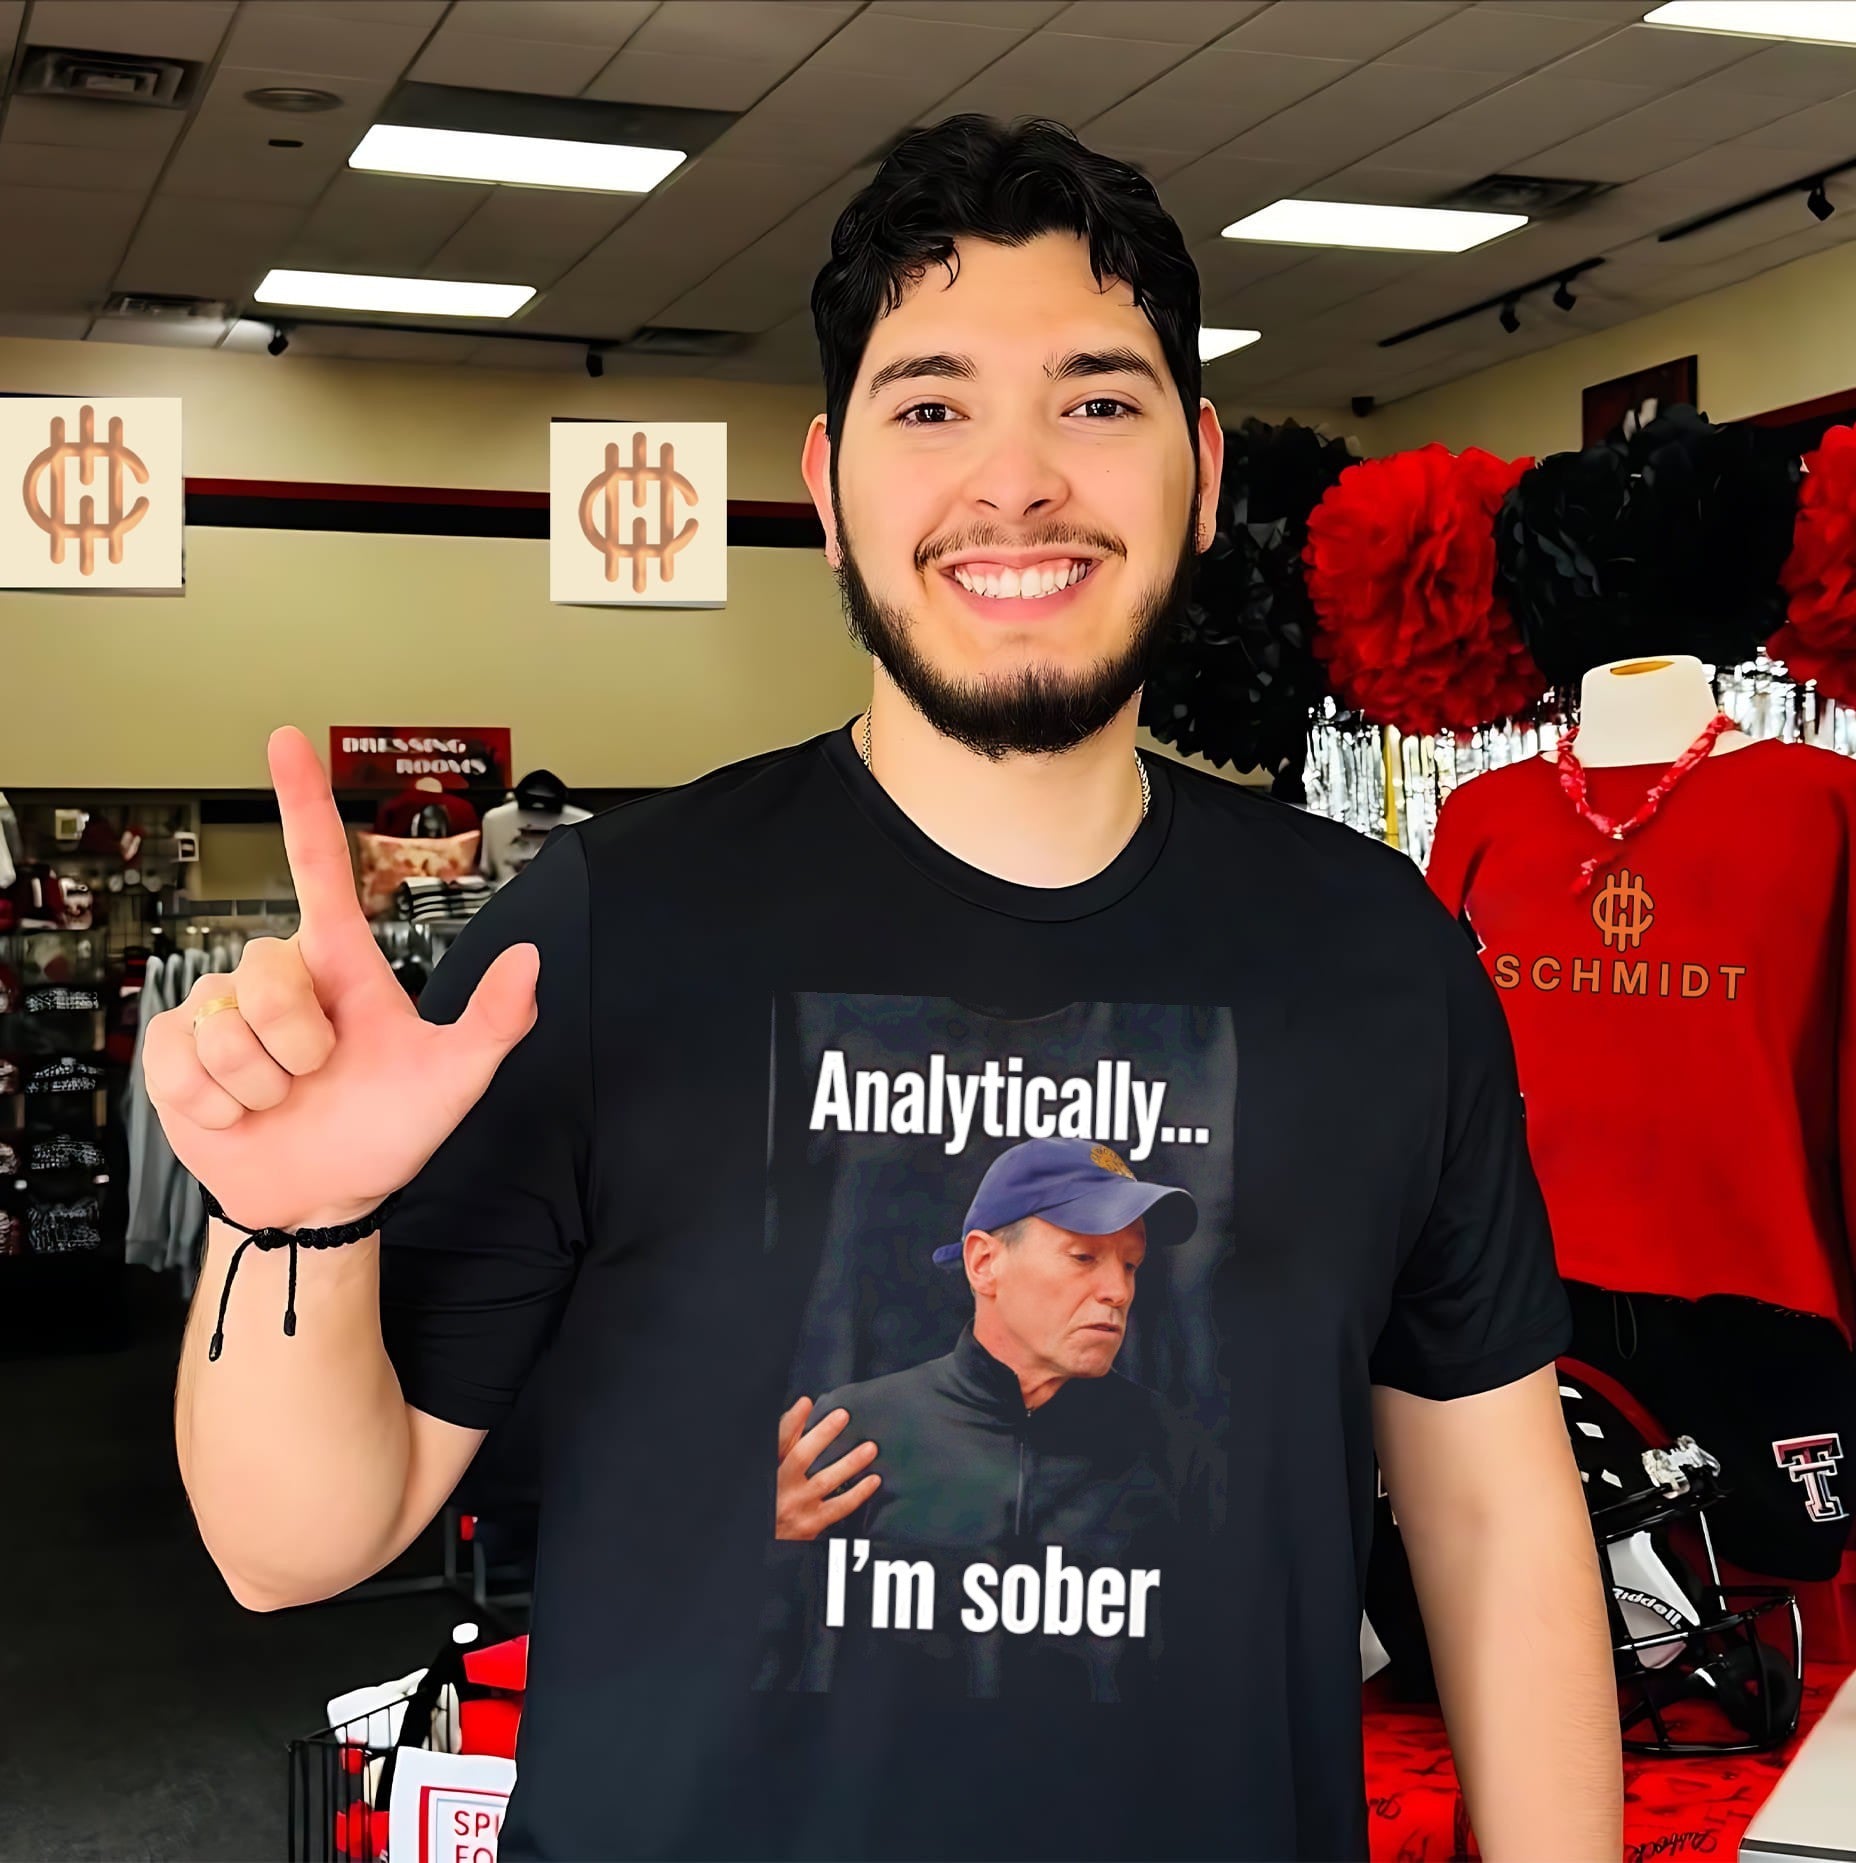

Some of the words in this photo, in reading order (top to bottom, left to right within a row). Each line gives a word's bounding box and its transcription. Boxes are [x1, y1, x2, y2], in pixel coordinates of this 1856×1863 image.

[342, 737, 467, 753] DRESSING
[396, 758, 487, 774] ROOMS
[1494, 954, 1746, 1000] SCHMIDT
[809, 1049, 1210, 1162] Analytically...
[826, 1538, 935, 1630] I’m
[960, 1545, 1161, 1638] sober
